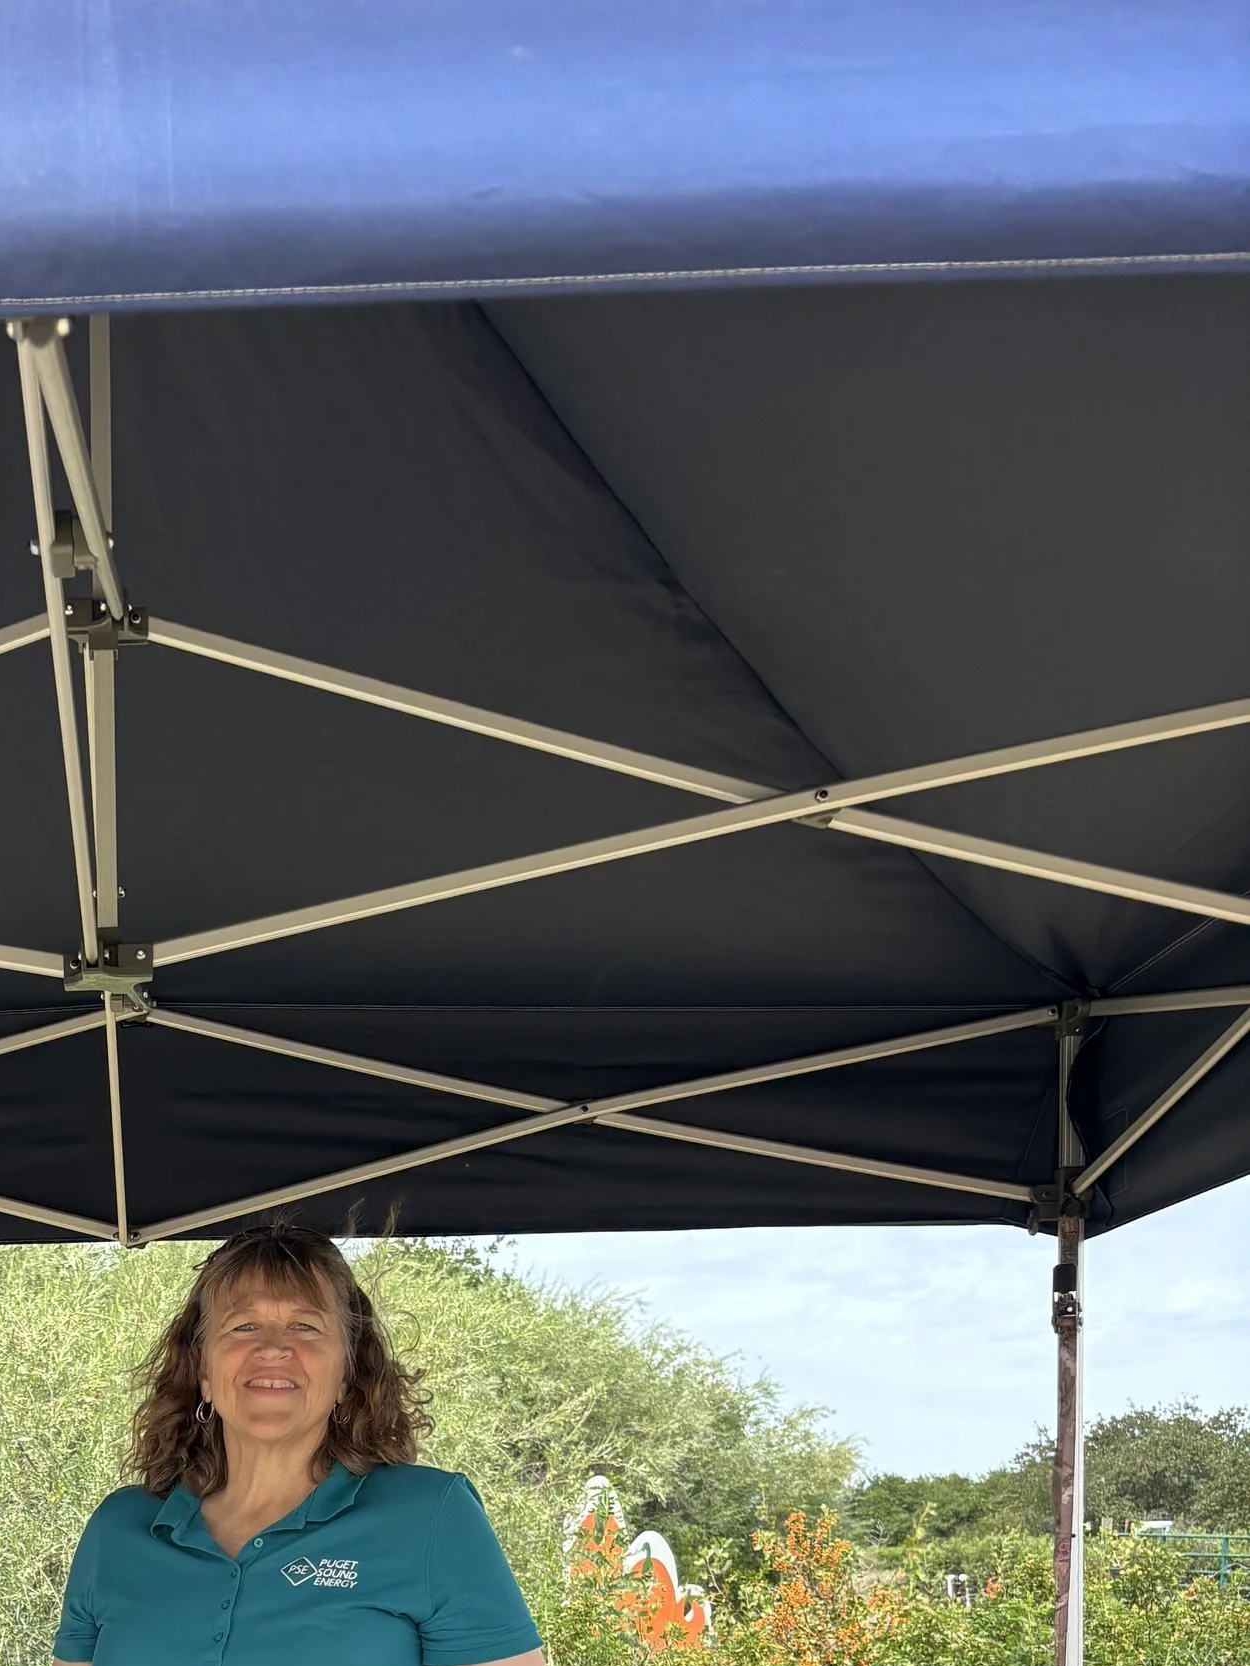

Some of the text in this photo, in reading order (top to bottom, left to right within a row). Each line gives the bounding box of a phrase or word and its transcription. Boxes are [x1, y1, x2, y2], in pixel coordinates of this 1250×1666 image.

[287, 1564, 309, 1575] PSE
[318, 1558, 359, 1570] PUGET
[316, 1568, 358, 1580] SOUND
[313, 1577, 358, 1589] ENERGY
